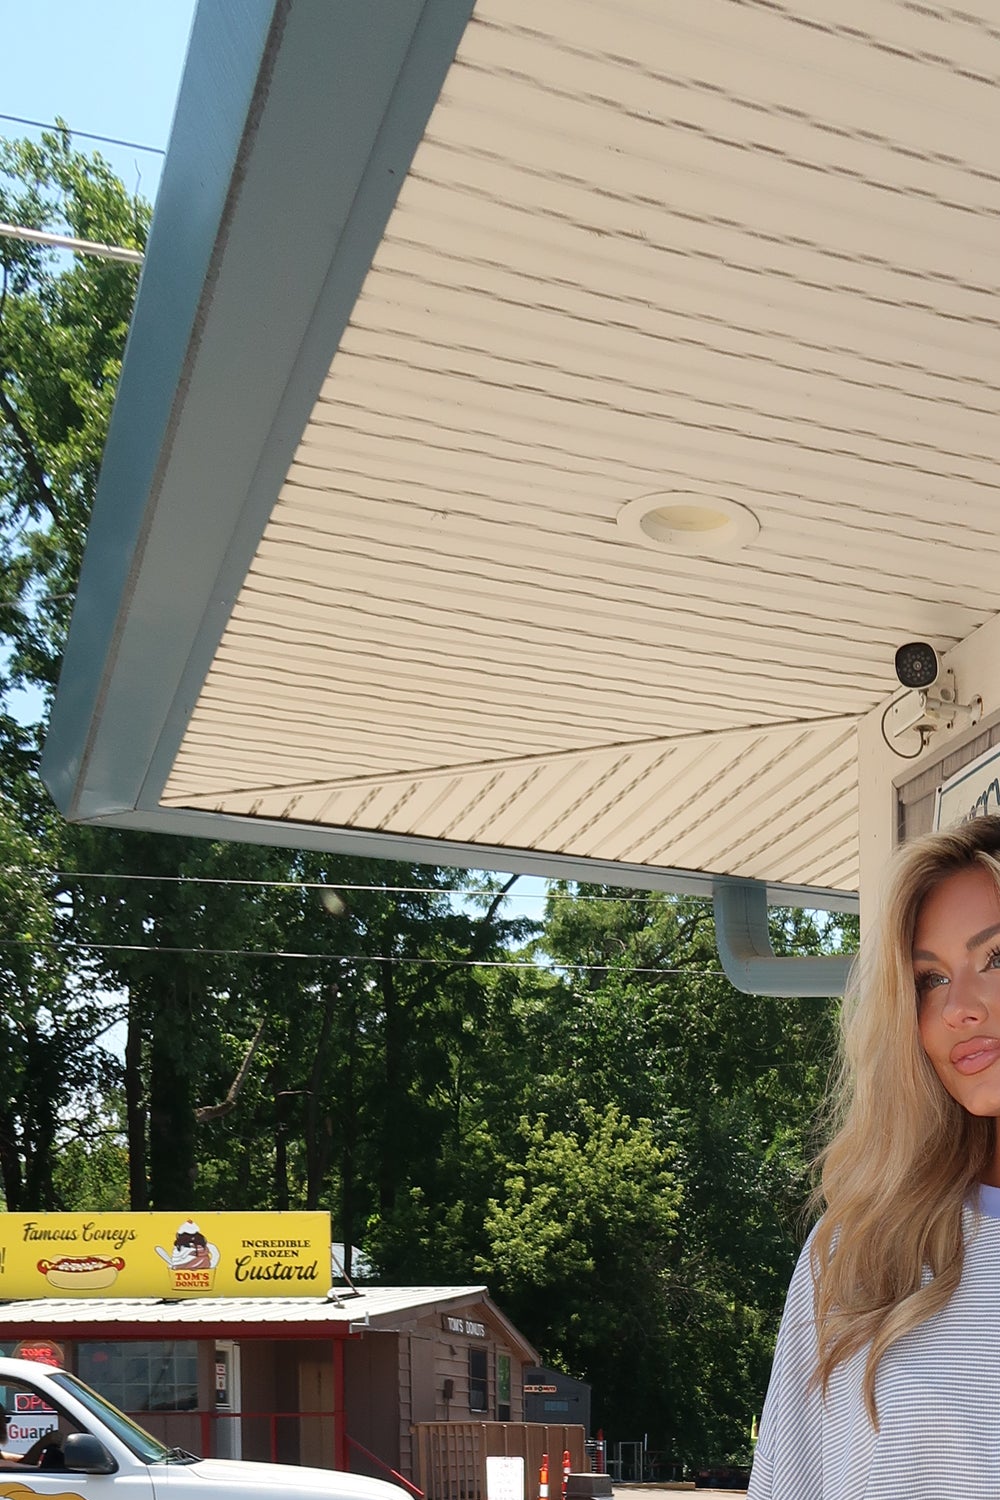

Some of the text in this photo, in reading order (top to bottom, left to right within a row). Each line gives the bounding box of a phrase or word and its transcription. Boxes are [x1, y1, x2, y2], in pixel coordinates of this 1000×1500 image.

[23, 1221, 137, 1250] Famous Coneys
[242, 1239, 311, 1248] INCREDIBLE
[253, 1250, 299, 1258] FROZEN
[234, 1255, 319, 1282] Custard
[175, 1272, 210, 1281] TOM'S
[465, 1320, 486, 1337] DONUTS
